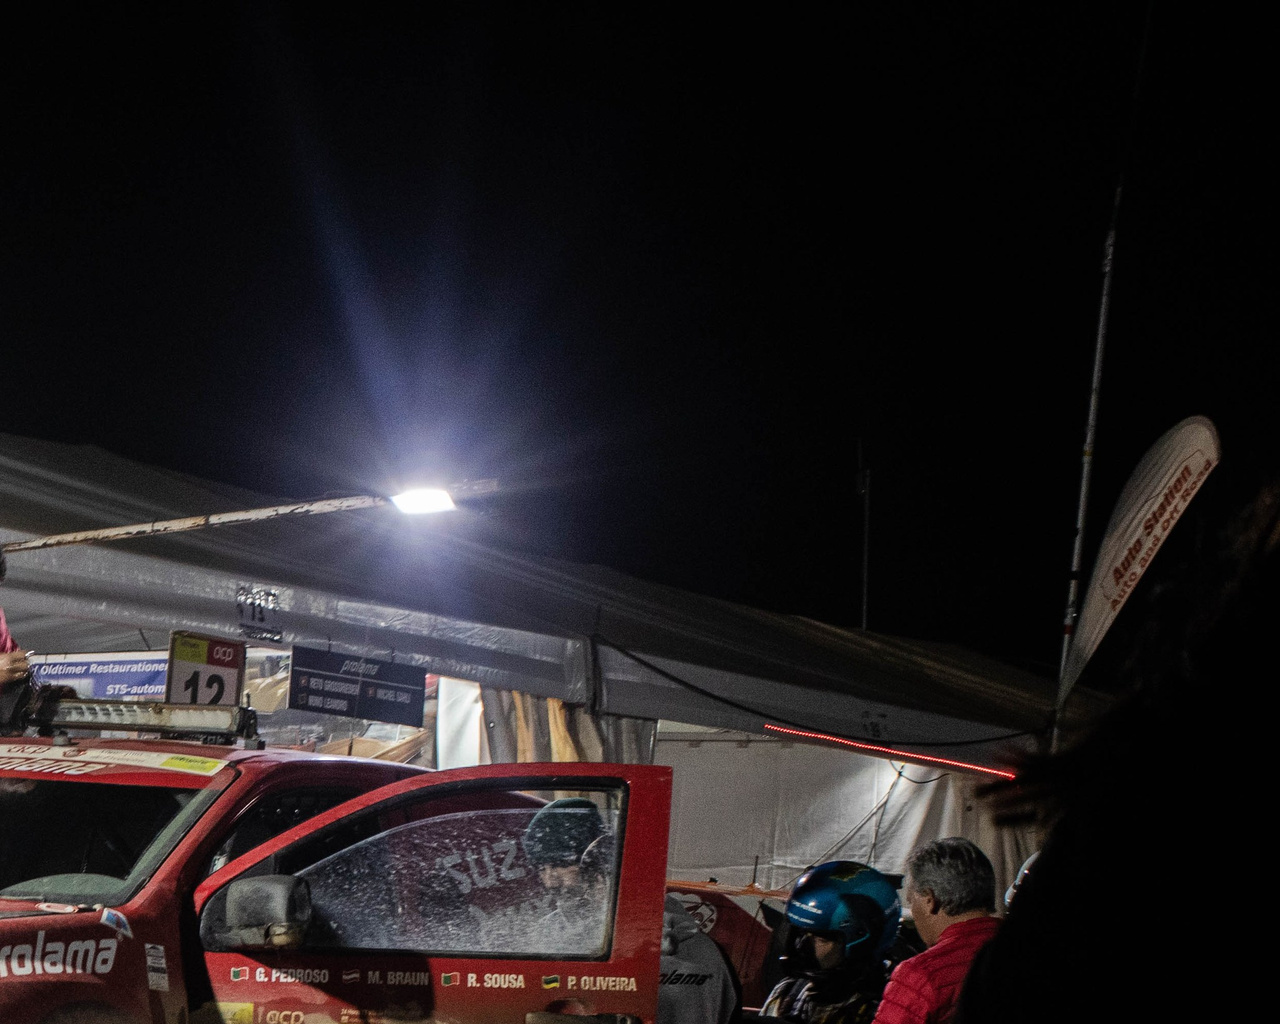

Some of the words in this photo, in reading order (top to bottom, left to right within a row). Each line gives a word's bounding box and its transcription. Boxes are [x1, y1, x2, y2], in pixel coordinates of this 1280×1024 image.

[1113, 538, 1142, 587] Auto
[1144, 465, 1192, 537] Station
[1111, 572, 1137, 611] Auto
[40, 664, 87, 675] Oldtimer
[184, 670, 225, 705] 12
[255, 967, 268, 983] G.
[271, 968, 329, 983] PEDROSO
[368, 971, 383, 985] M.
[387, 971, 429, 986] BRAUN
[467, 973, 480, 988] R.
[484, 973, 525, 989] SOUSA
[568, 975, 578, 990] P.
[580, 976, 637, 992] OLIVEIRA
